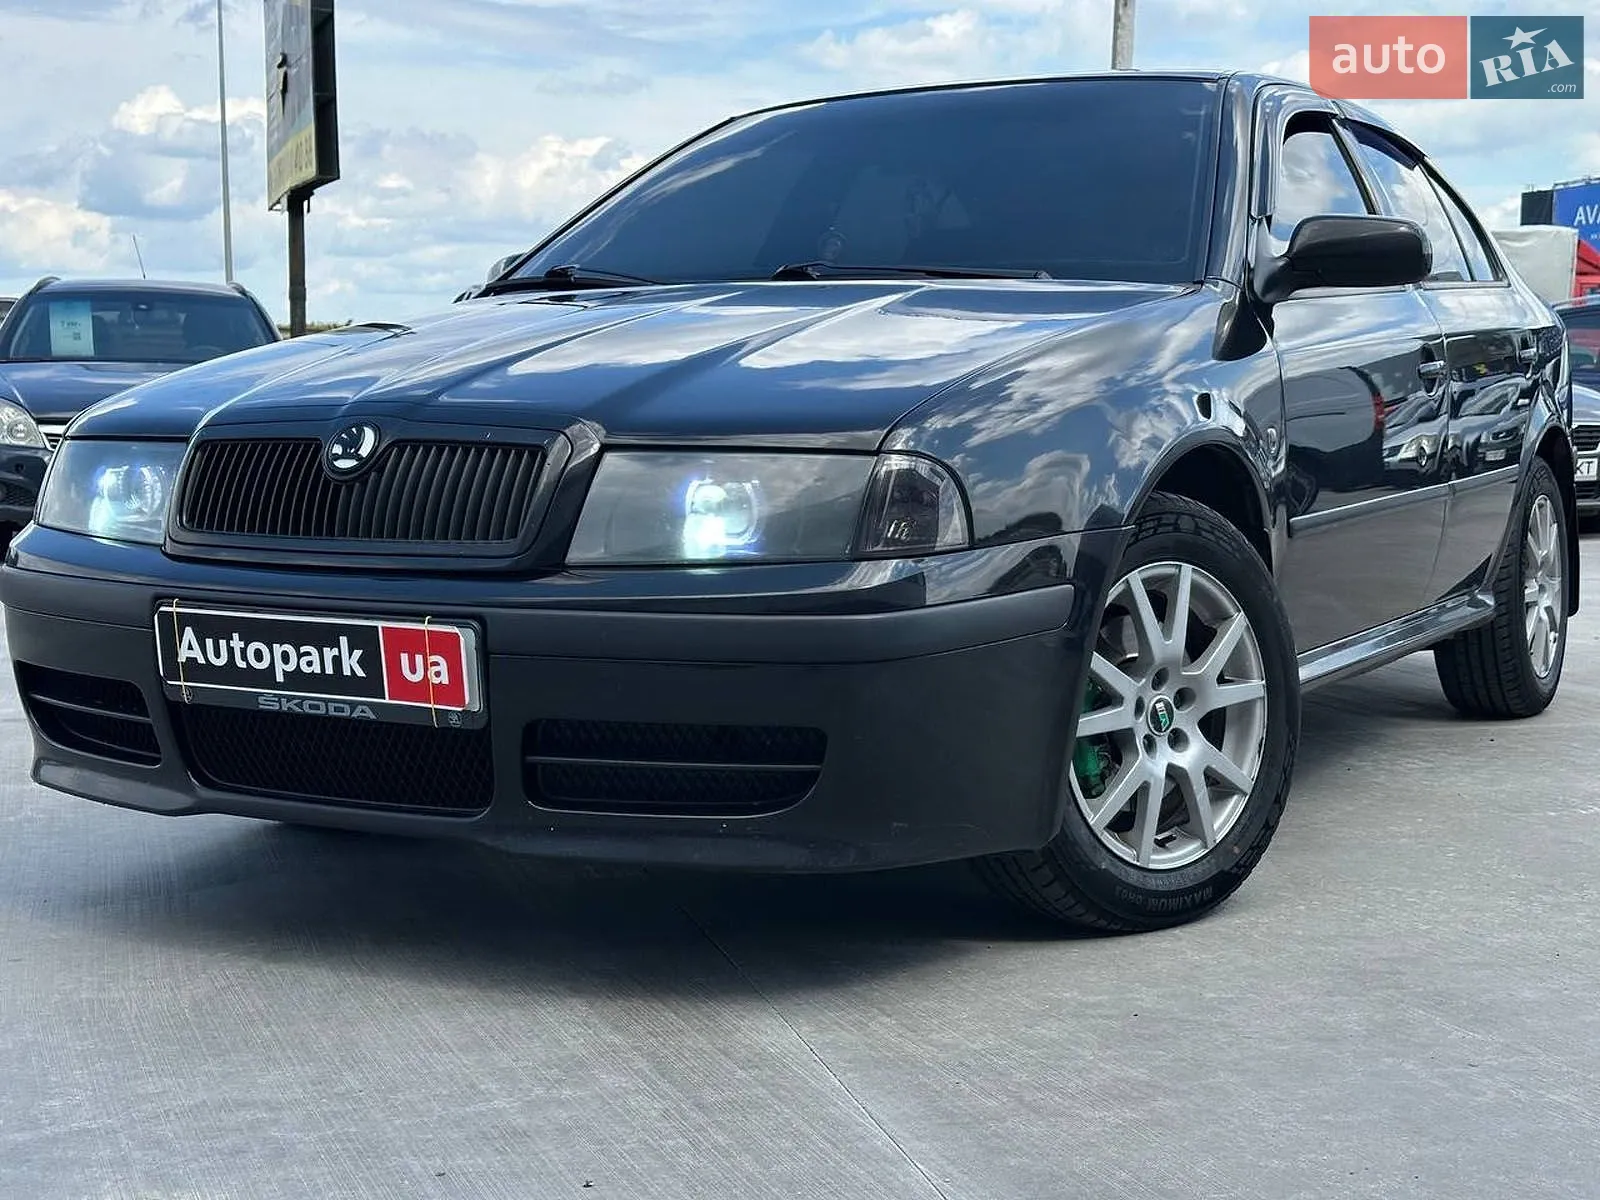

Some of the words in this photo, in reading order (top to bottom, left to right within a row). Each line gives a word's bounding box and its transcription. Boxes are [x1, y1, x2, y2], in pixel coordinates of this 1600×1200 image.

[177, 626, 366, 682] Autopark
[400, 651, 450, 685] ua
[258, 693, 377, 719] ŠKODA
